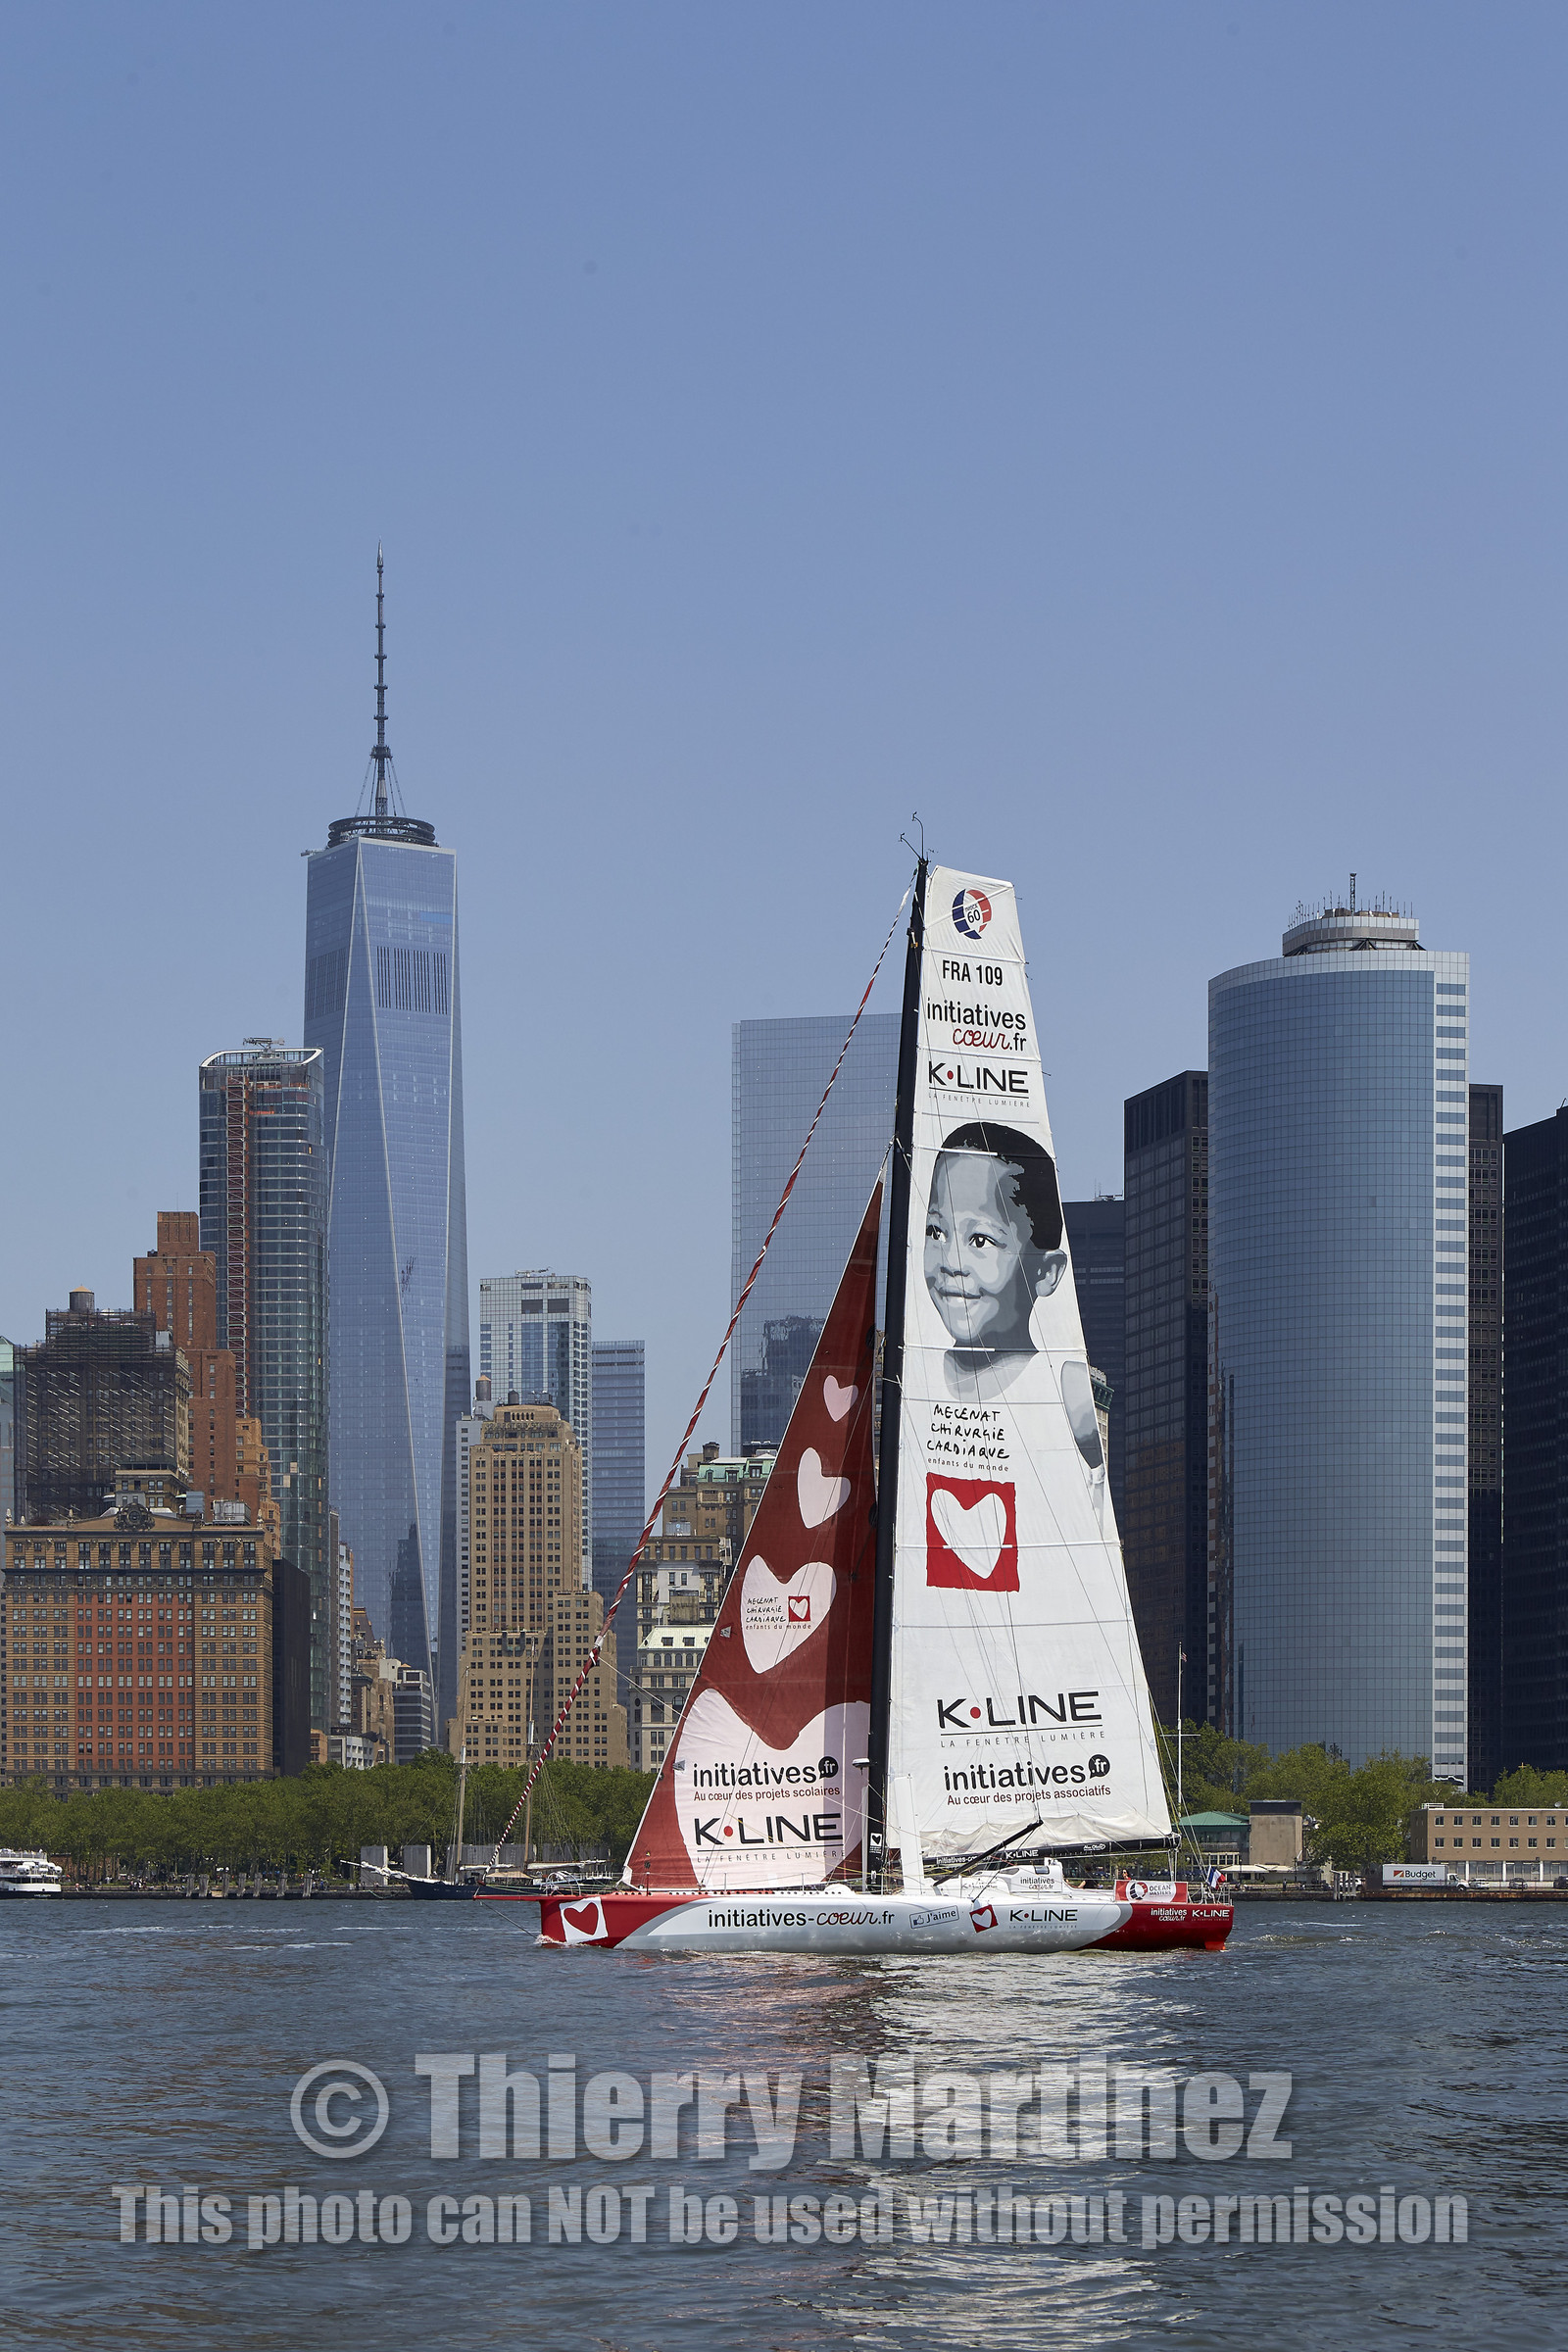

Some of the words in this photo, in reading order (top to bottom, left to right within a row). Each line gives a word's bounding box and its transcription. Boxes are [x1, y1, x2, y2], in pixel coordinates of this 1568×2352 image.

[967, 909, 980, 923] 60
[943, 960, 971, 982] FRA
[976, 964, 1003, 986] 109
[927, 998, 1026, 1030] initiatives
[928, 1458, 959, 1467] enfants
[940, 1740, 956, 1748] LA
[694, 1790, 707, 1801] Au
[735, 1789, 753, 1800] des
[756, 1788, 791, 1802] projets
[793, 1786, 840, 1798] scolaires
[947, 1794, 960, 1805] Au
[993, 1791, 1011, 1802] des
[1014, 1788, 1051, 1804] projets
[1054, 1785, 1111, 1799] associatifs
[1405, 1870, 1436, 1880] Budget
